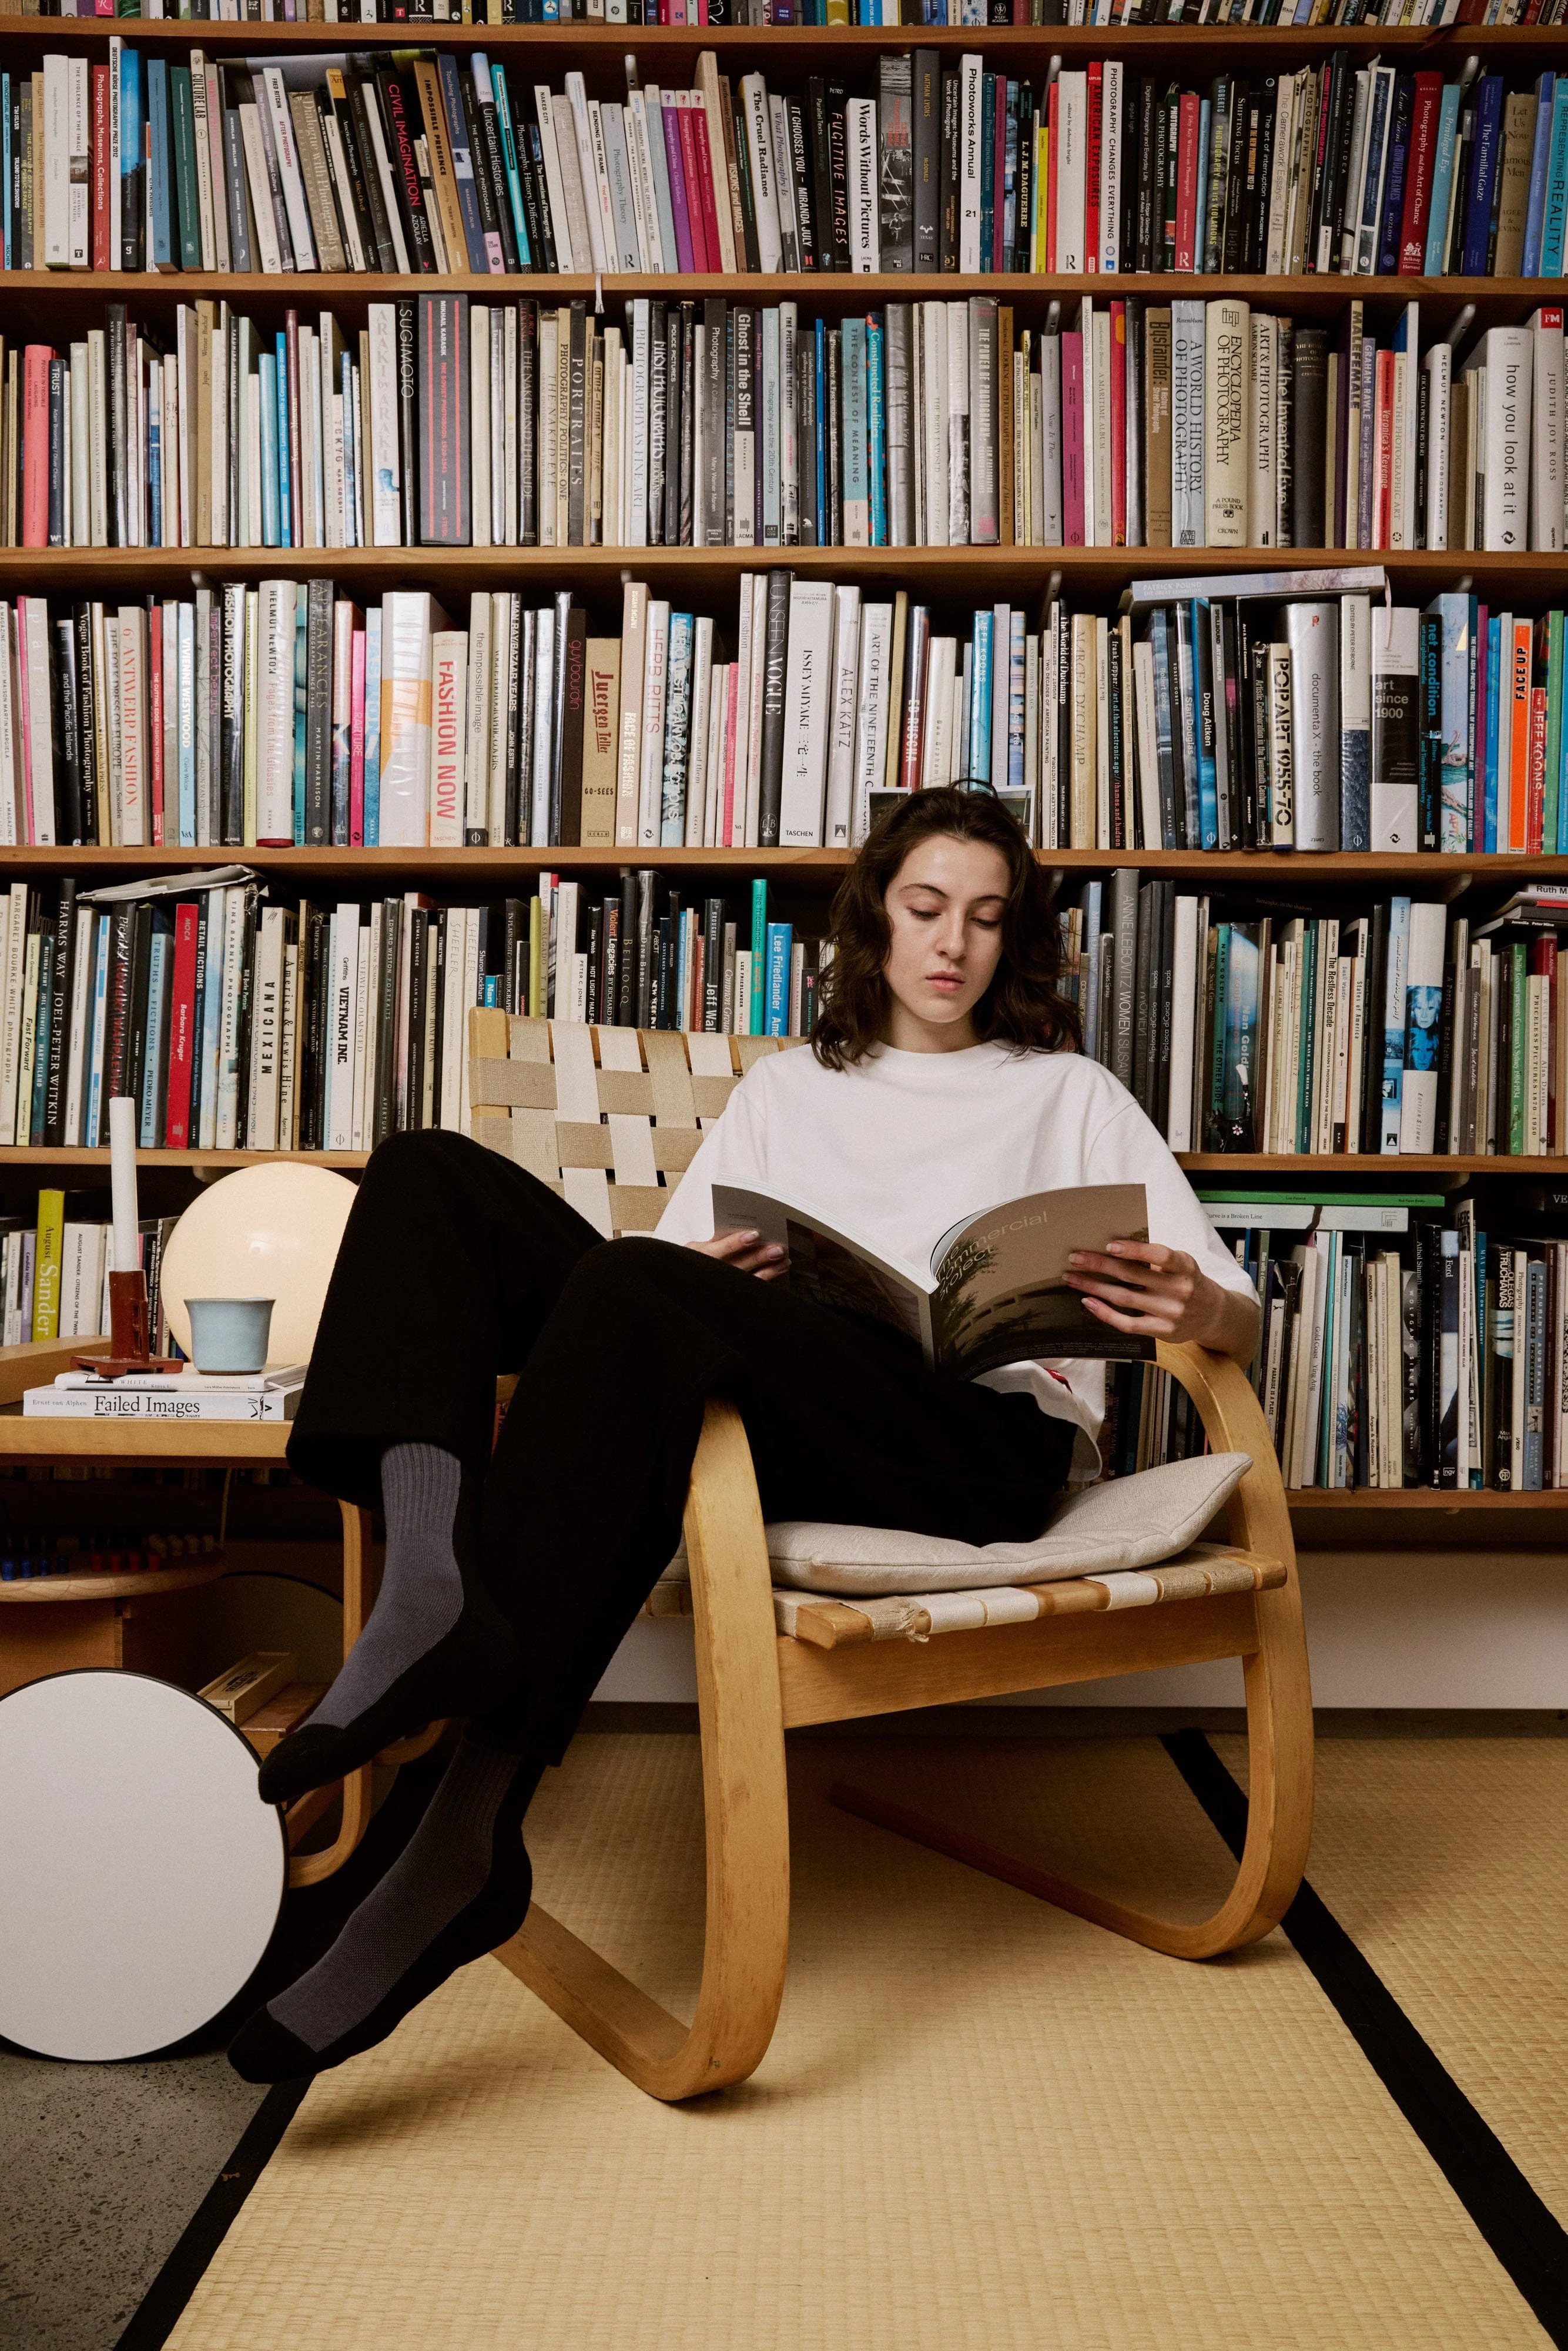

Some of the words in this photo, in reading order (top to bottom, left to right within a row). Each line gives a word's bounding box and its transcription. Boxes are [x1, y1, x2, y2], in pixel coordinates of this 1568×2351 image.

[968, 68, 977, 136] Photoworks
[1109, 68, 1117, 134] PHOTOGRAPHY
[483, 108, 498, 154] Uncertain
[592, 110, 601, 138] BENDING
[859, 104, 870, 143] Words
[1482, 123, 1492, 141] The
[388, 84, 404, 118] CIVIL
[396, 120, 421, 206] IMAGINATION
[967, 138, 976, 179] Annual
[1478, 142, 1490, 178] Familial
[488, 155, 505, 196] Histories
[859, 146, 872, 196] Without
[1476, 179, 1486, 200] Gaze
[411, 214, 422, 245] AZOULAY
[418, 216, 429, 242] ARIELLA
[860, 199, 872, 249] Pictures
[738, 314, 751, 351] Ghost
[1175, 339, 1187, 361] OF
[1190, 340, 1201, 351] A
[399, 309, 414, 398] SUGIMOTO
[739, 353, 751, 366] in
[1150, 322, 1170, 385] Bystander:
[739, 369, 751, 389] the
[1190, 357, 1201, 416] WORLD
[1506, 365, 1520, 398] how
[571, 358, 583, 485] PORTRAITS
[738, 393, 751, 426] Shell
[1502, 404, 1516, 433] you
[1175, 366, 1187, 494] PHOTOGRAPHY
[1190, 423, 1201, 495] HISTORY
[1504, 441, 1517, 475] look
[1503, 482, 1516, 497] at
[1504, 505, 1516, 514] it
[182, 638, 190, 685] VIVIENNE
[802, 649, 813, 682] ISSEY
[1516, 647, 1526, 664] UP
[123, 645, 136, 729] ANTWERP
[593, 671, 614, 728] Juergen
[840, 668, 853, 705] ALEX
[1311, 674, 1321, 731] documenta
[1515, 667, 1527, 701] FACE
[182, 687, 190, 748] WESTWOOD
[438, 661, 457, 756] FASHION
[799, 685, 811, 729] MIYAKE
[908, 699, 920, 714] ED
[1201, 692, 1211, 716] Doug
[598, 732, 611, 753] Teller
[839, 711, 852, 748] KATZ
[905, 718, 919, 762] RUSCHA
[1204, 718, 1212, 746] Aitken
[125, 735, 138, 805] FASHION
[796, 733, 809, 778] 三宅一生
[1312, 750, 1321, 768] the
[437, 765, 456, 819] NOW
[1313, 770, 1322, 796] book
[58, 900, 69, 946] HARMS
[608, 909, 618, 937] Violent
[1121, 895, 1134, 929] ANNIE
[197, 920, 206, 948] RETAIL
[772, 935, 783, 953] Lee
[56, 952, 66, 978] WAY
[196, 951, 205, 989] FICTIONS
[607, 938, 617, 975] Legacies
[619, 939, 632, 1007] BELLOCQ
[1120, 933, 1133, 988] LEIBOVITZ
[1328, 957, 1337, 969] The
[770, 955, 782, 1010] Friedlander
[1326, 971, 1336, 1000] Restless
[50, 992, 64, 1071] JOEL-PETER
[261, 982, 275, 1074] MEXICANA
[338, 987, 349, 1040] VIETNAM
[1118, 992, 1131, 1036] WOMEN
[1325, 1002, 1335, 1027] Decade
[337, 1043, 348, 1065] INC.
[1117, 1039, 1129, 1077] SUSAN
[47, 1074, 59, 1125] WITKIN
[43, 1225, 55, 1258] August
[1445, 1260, 1454, 1277] Ford
[1499, 1252, 1509, 1308] TRUCHANAS
[36, 1264, 58, 1336] Sander
[1516, 1272, 1525, 1310] Photography
[1310, 1365, 1319, 1378] Ying
[94, 1395, 140, 1412] Failed
[146, 1396, 200, 1417] Images
